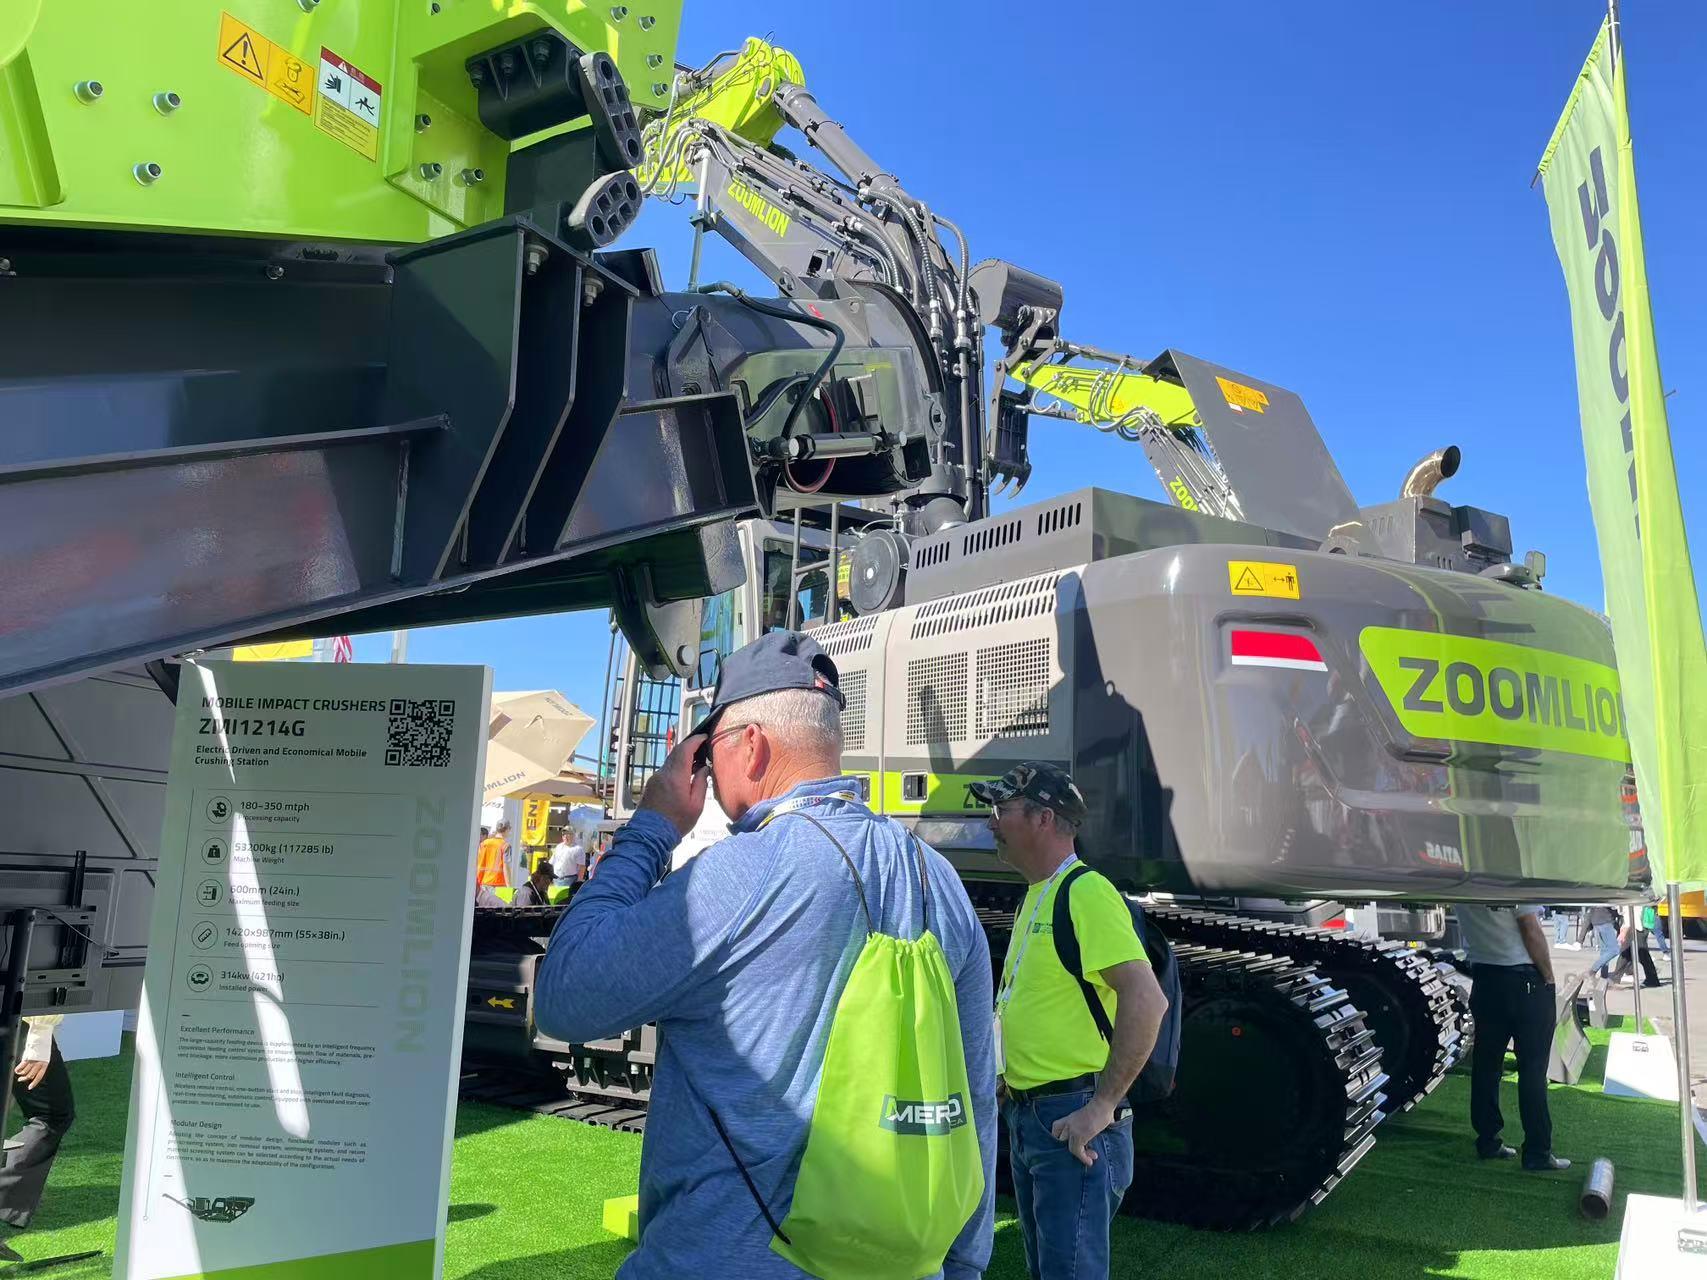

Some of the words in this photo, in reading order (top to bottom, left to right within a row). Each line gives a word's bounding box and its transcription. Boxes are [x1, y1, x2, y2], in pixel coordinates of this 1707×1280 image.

[727, 177, 790, 238] ZOOMLION
[202, 697, 254, 709] MOBILE
[257, 698, 310, 710] IMPACT
[313, 699, 386, 712] CRUSHERS
[198, 718, 306, 736] ZMI1214G
[196, 745, 229, 754] Electric
[231, 746, 261, 755] Driven
[263, 746, 280, 756] and
[282, 747, 334, 757] Economical
[336, 748, 367, 758] Mobile
[195, 757, 234, 767] Crushing
[237, 757, 269, 766] Station
[284, 802, 310, 813] mtph
[238, 814, 273, 823] Processing
[279, 844, 319, 854] (117285
[321, 845, 334, 855] lb)
[233, 855, 261, 863] Machine
[230, 885, 267, 895] 600mm
[269, 886, 300, 897] (24in.)
[261, 899, 286, 907] feeding
[223, 940, 240, 948] Feed
[241, 941, 266, 950] opening
[221, 970, 250, 980] 314kw
[251, 972, 285, 982] (421hp)
[219, 984, 247, 992] Installed
[248, 985, 268, 993] power
[180, 1025, 210, 1033] Excellent
[211, 1027, 255, 1035] Performance
[175, 1071, 209, 1080] Intelligent
[210, 1073, 235, 1081] Control
[171, 1119, 198, 1128] Modular
[199, 1120, 223, 1130] Design
